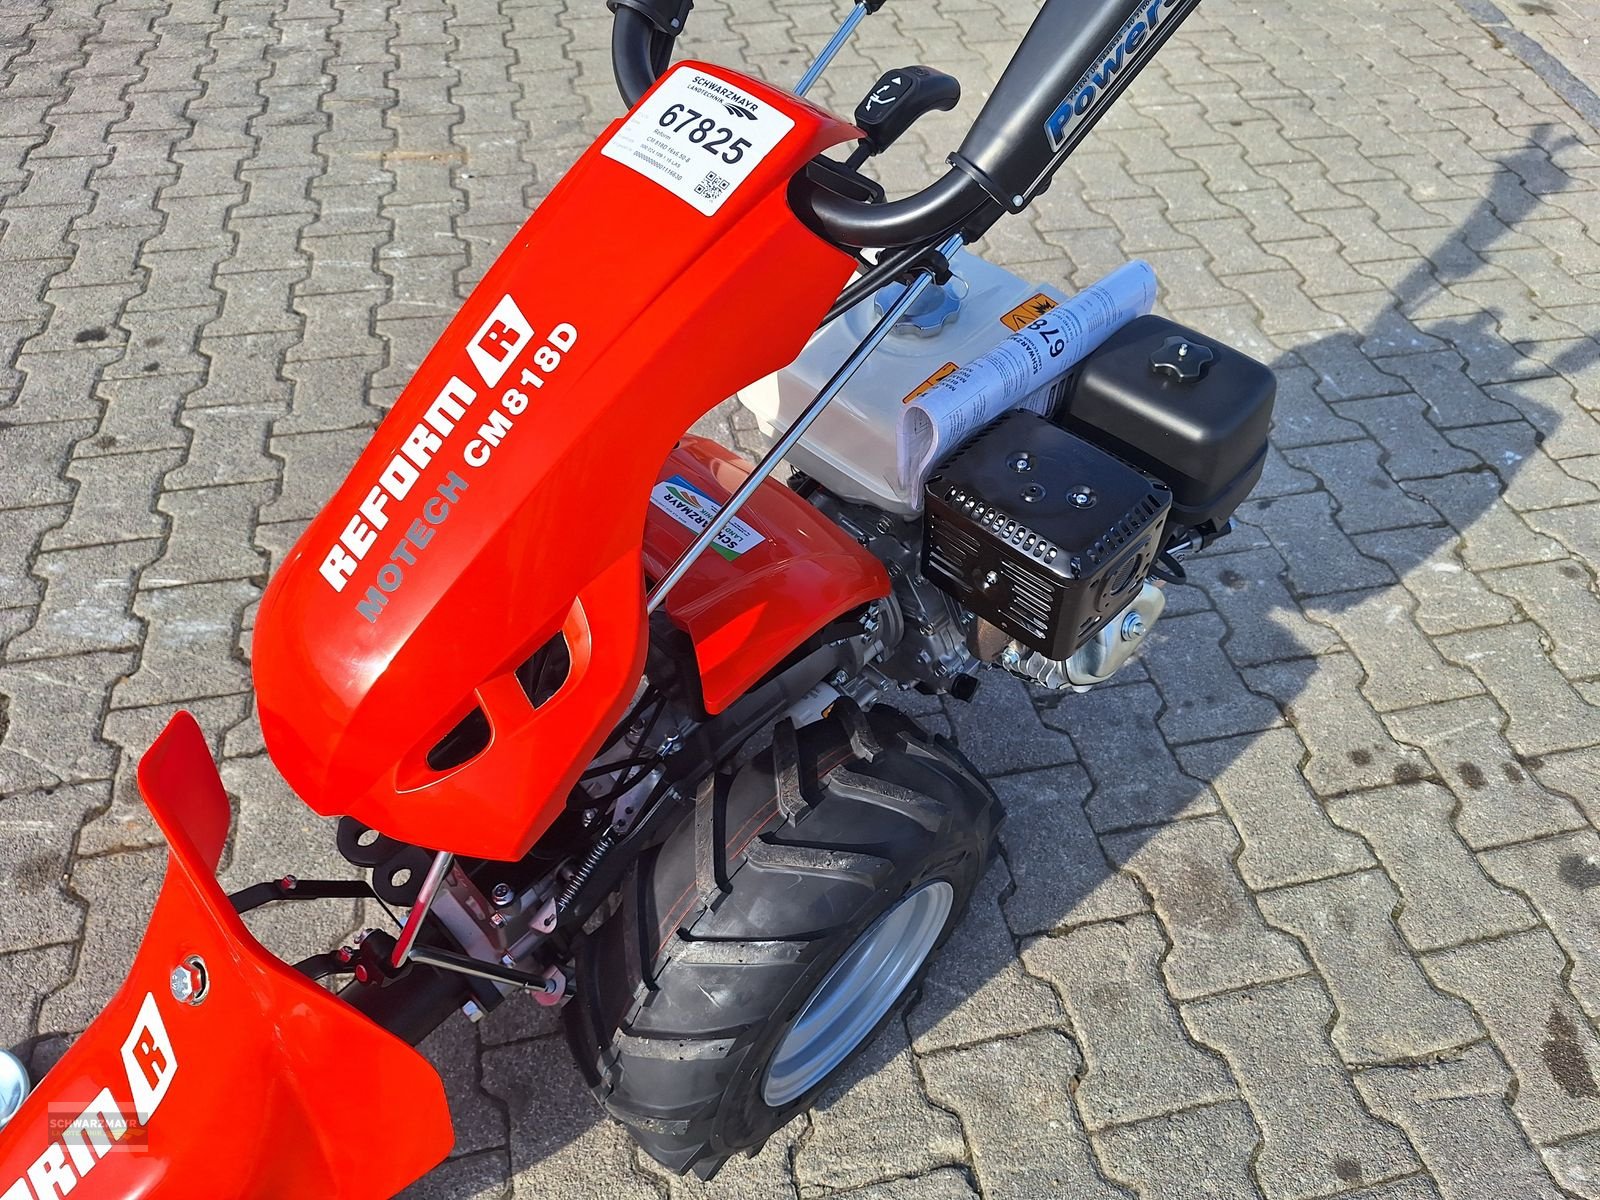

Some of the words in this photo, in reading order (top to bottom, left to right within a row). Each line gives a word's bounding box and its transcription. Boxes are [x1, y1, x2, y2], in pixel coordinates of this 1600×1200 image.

[687, 83, 724, 104] LANDTECHNIK
[692, 75, 759, 112] SCHWARZMAYR
[1050, 0, 1178, 147] Power
[653, 128, 671, 141] Reform
[659, 103, 752, 165] 67825
[1027, 319, 1065, 358] 678
[318, 375, 478, 592] REFORM
[355, 471, 470, 623] MOTECH
[663, 493, 738, 550] SCHARZMAYR
